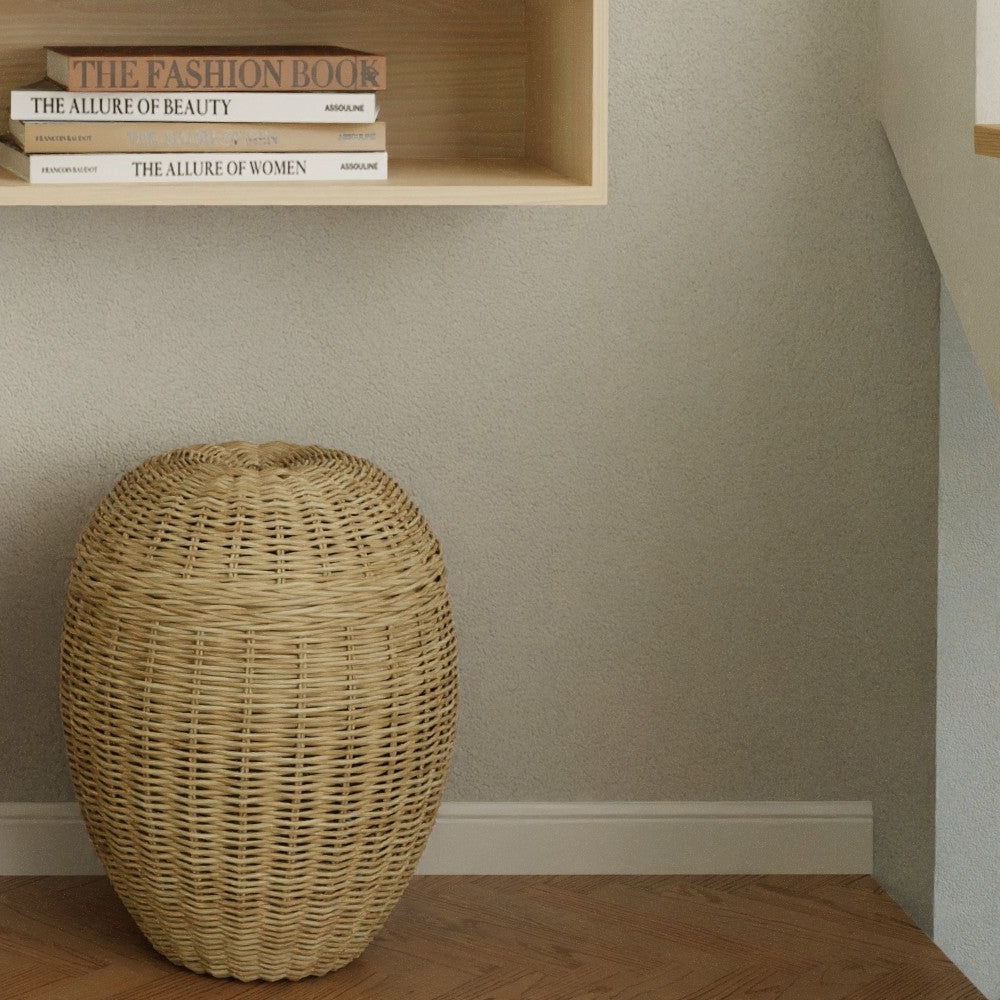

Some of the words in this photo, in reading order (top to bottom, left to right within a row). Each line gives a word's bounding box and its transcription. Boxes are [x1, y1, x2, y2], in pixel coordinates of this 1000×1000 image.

[73, 60, 139, 88] THE
[147, 59, 283, 88] FASHION
[292, 58, 380, 87] BOOK
[31, 97, 65, 114] THE
[69, 96, 135, 114] ALLURE
[137, 97, 161, 114] OF
[164, 97, 232, 115] BEAUTY
[325, 104, 365, 112] ASSOULINE
[132, 161, 163, 176] THE
[165, 161, 223, 176] ALLURE
[226, 160, 246, 176] OF
[249, 160, 307, 176] WOMEN
[340, 163, 378, 171] ASSOULINE
